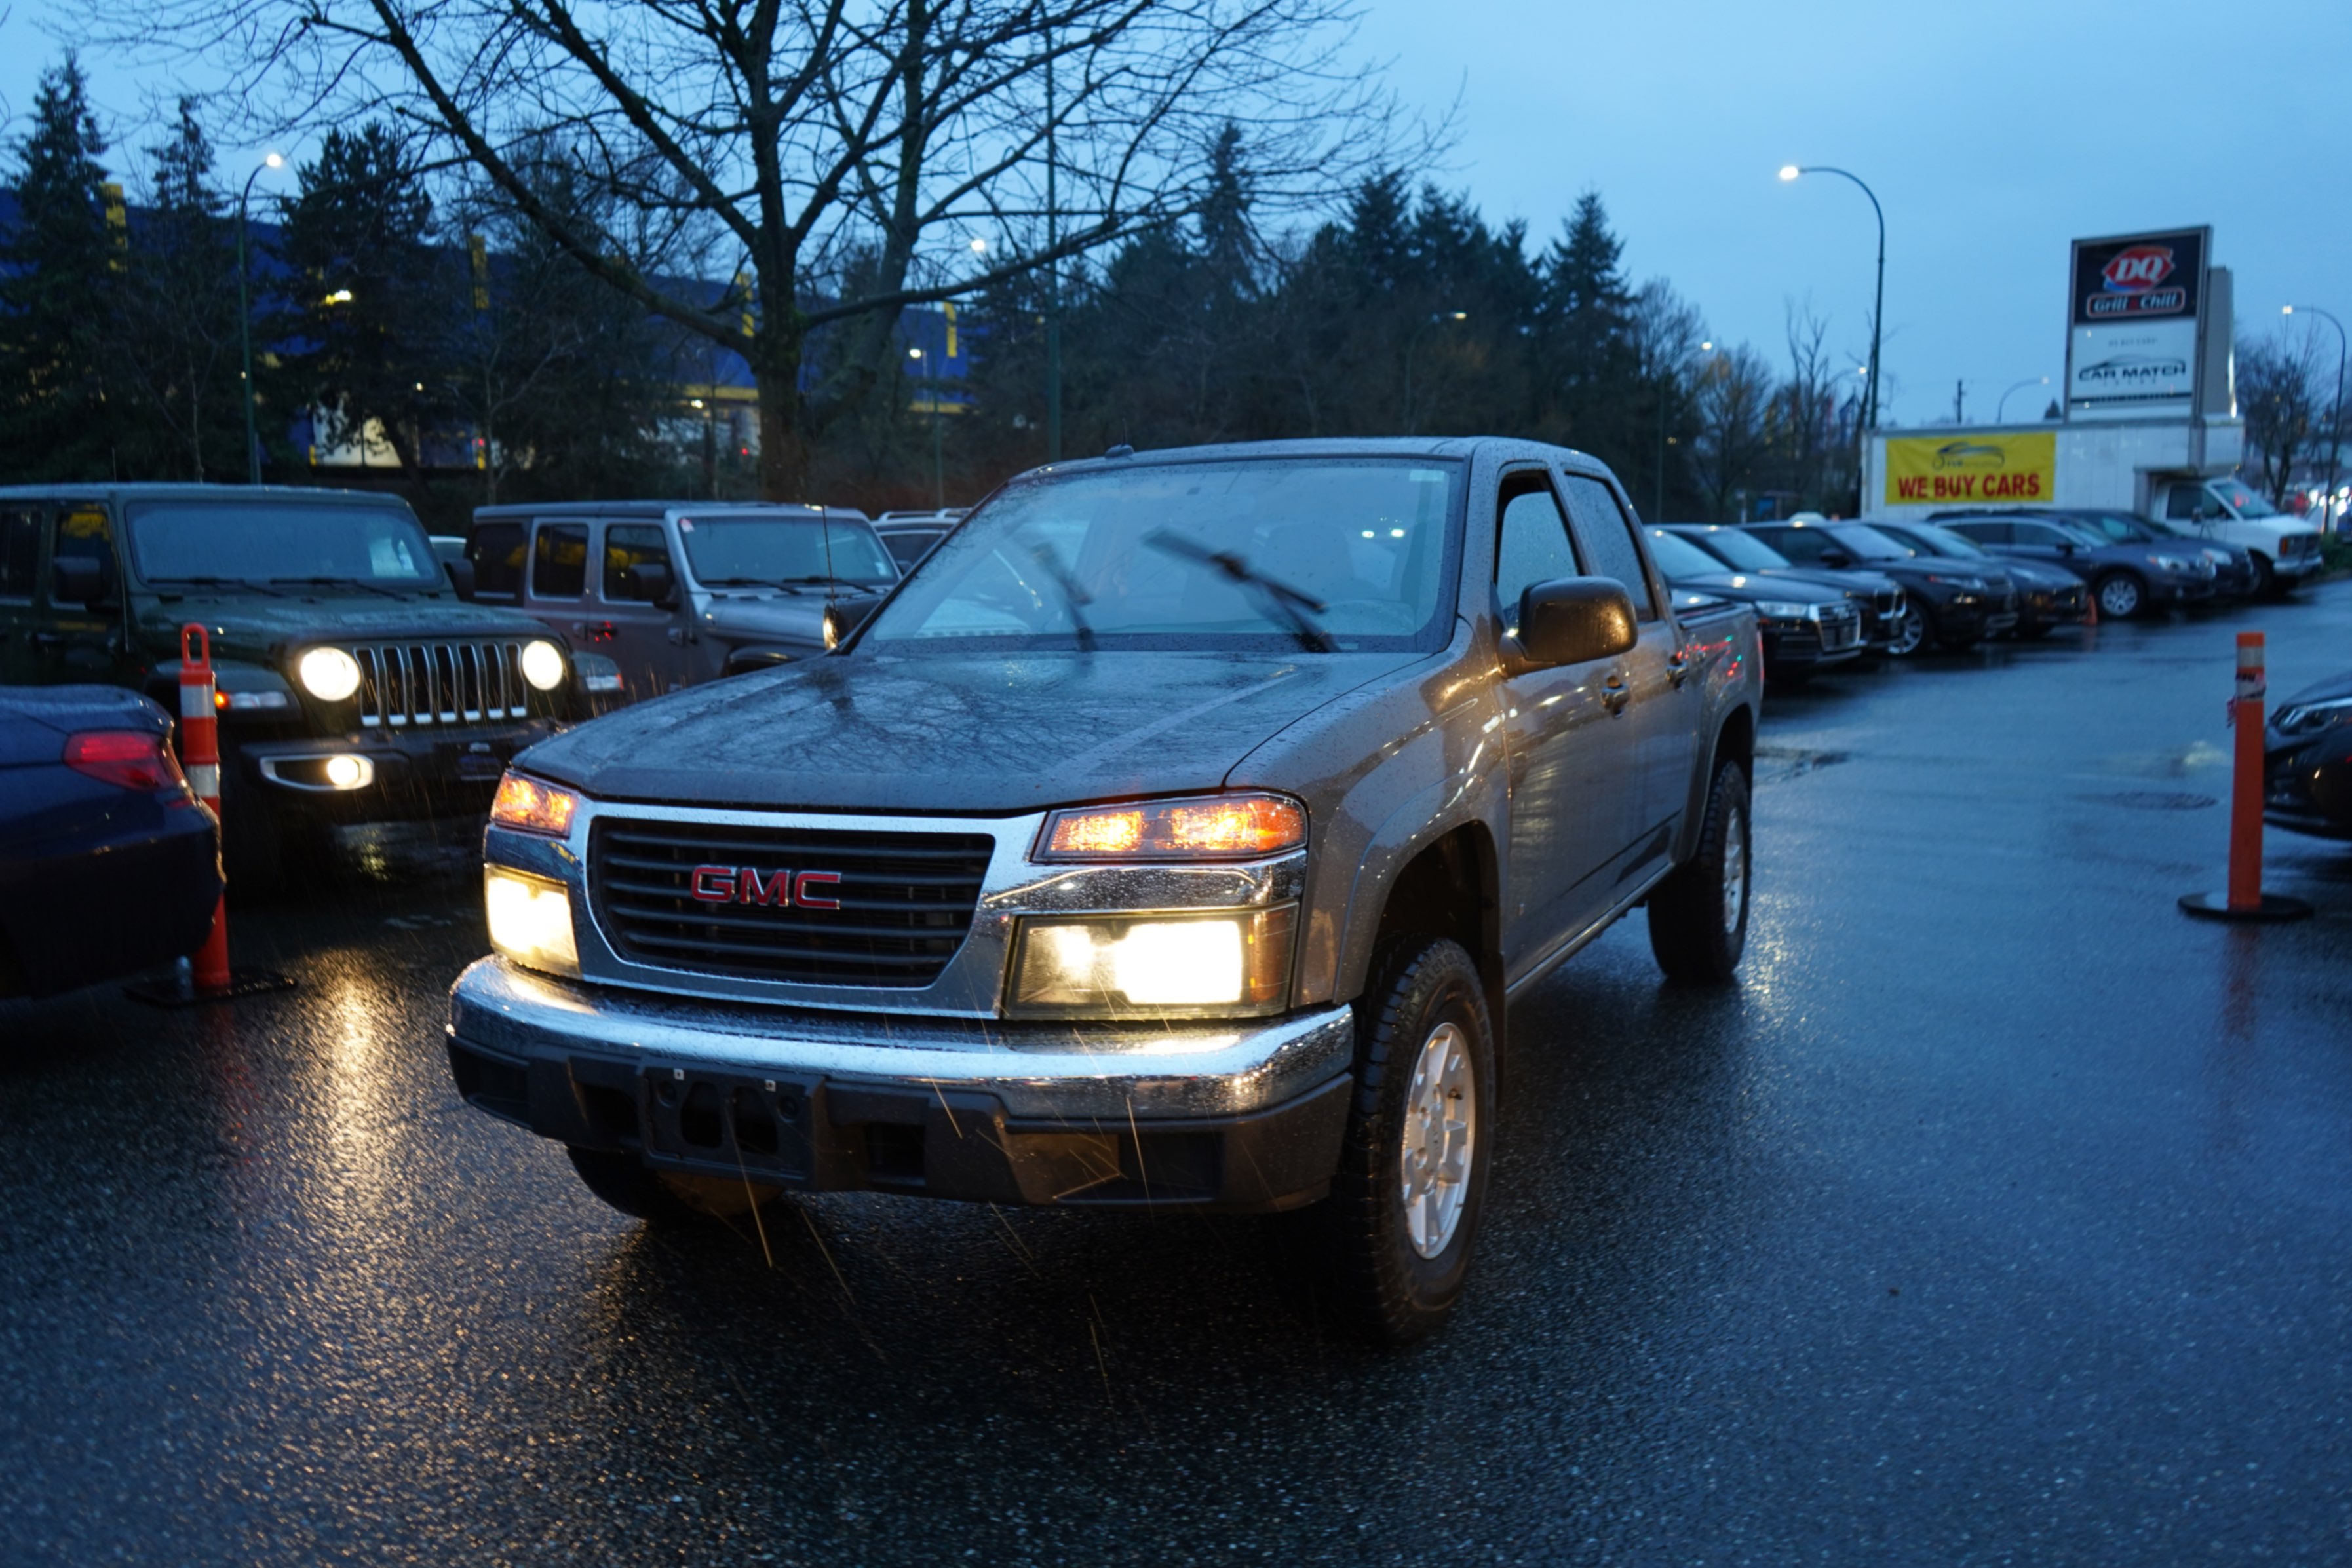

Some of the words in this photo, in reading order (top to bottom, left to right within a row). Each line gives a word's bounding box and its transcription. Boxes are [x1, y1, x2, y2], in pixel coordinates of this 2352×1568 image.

[2115, 256, 2163, 282] DQ
[2093, 295, 2129, 312] Grill
[2140, 292, 2178, 309] Chill
[2079, 368, 2116, 381] CAR
[2122, 363, 2186, 379] MATCH
[1898, 476, 1928, 499] WE
[1934, 474, 1976, 497] BUY
[1982, 472, 2040, 497] CARS
[691, 864, 842, 910] GMC
